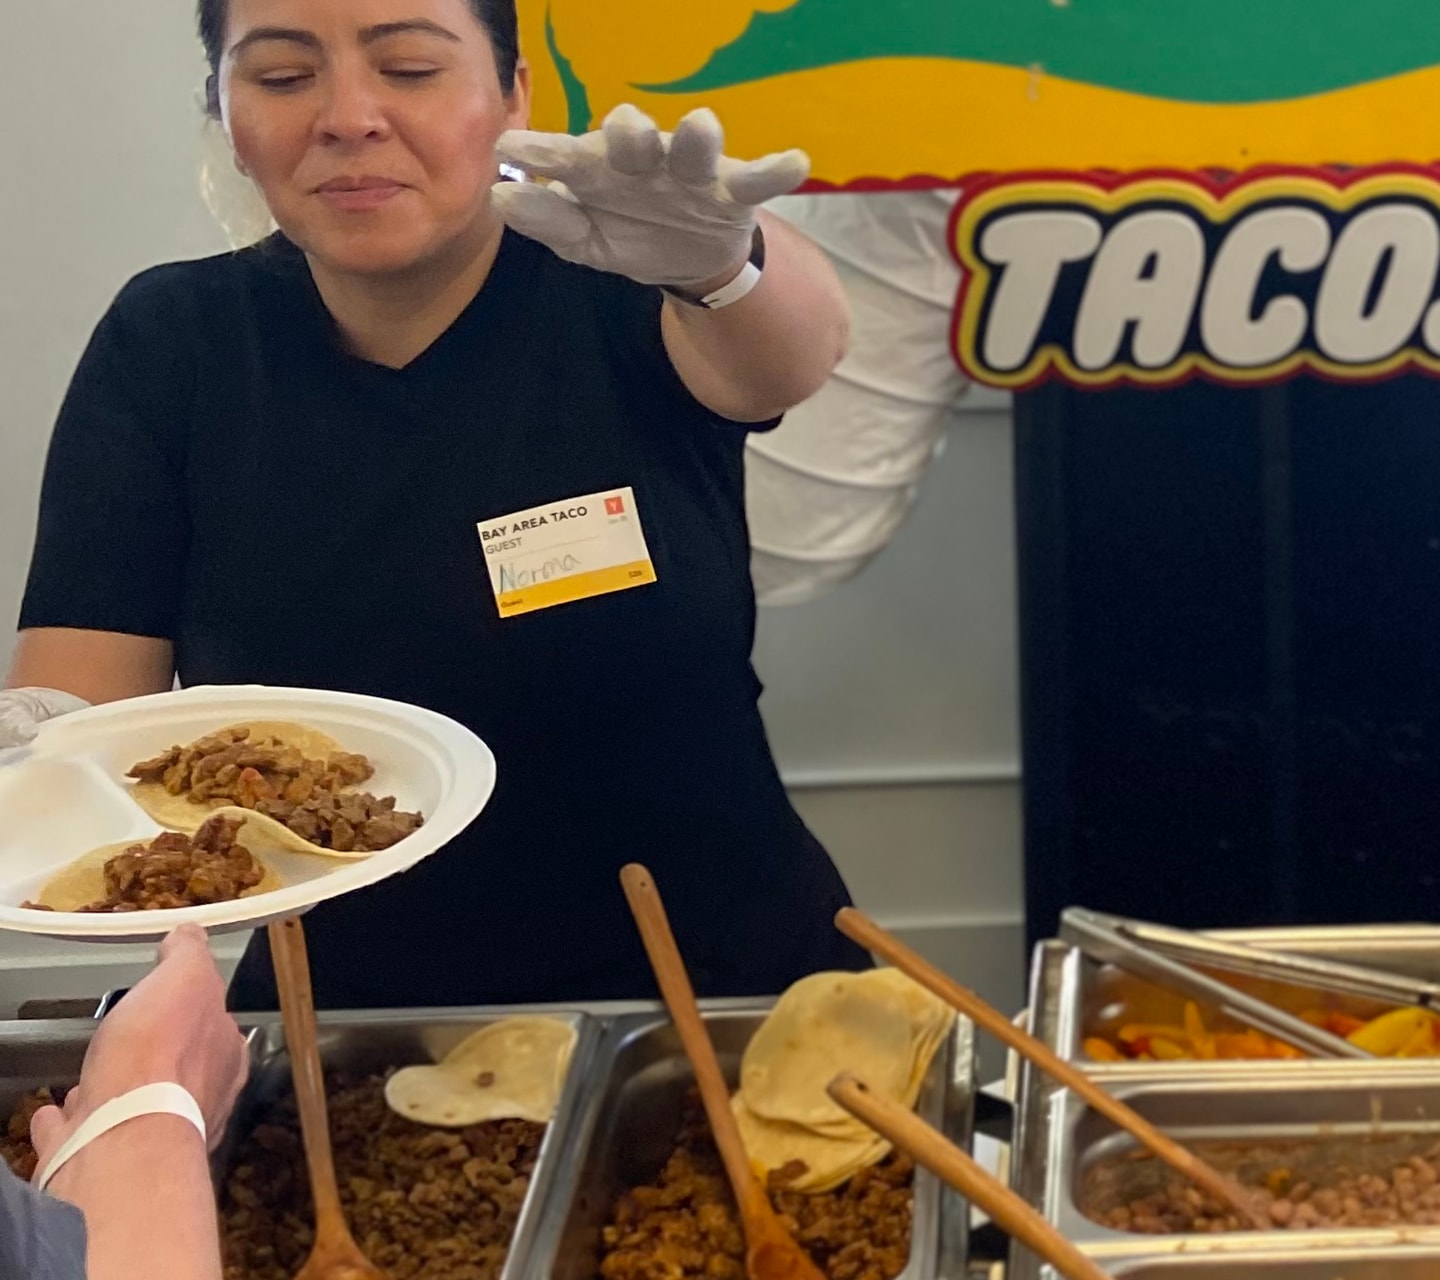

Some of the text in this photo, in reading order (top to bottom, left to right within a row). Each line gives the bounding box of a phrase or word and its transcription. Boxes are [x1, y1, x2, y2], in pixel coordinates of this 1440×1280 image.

[481, 525, 508, 541] BAY
[512, 516, 549, 534] AREA
[550, 506, 588, 522] TACO
[485, 536, 523, 555] GUEST
